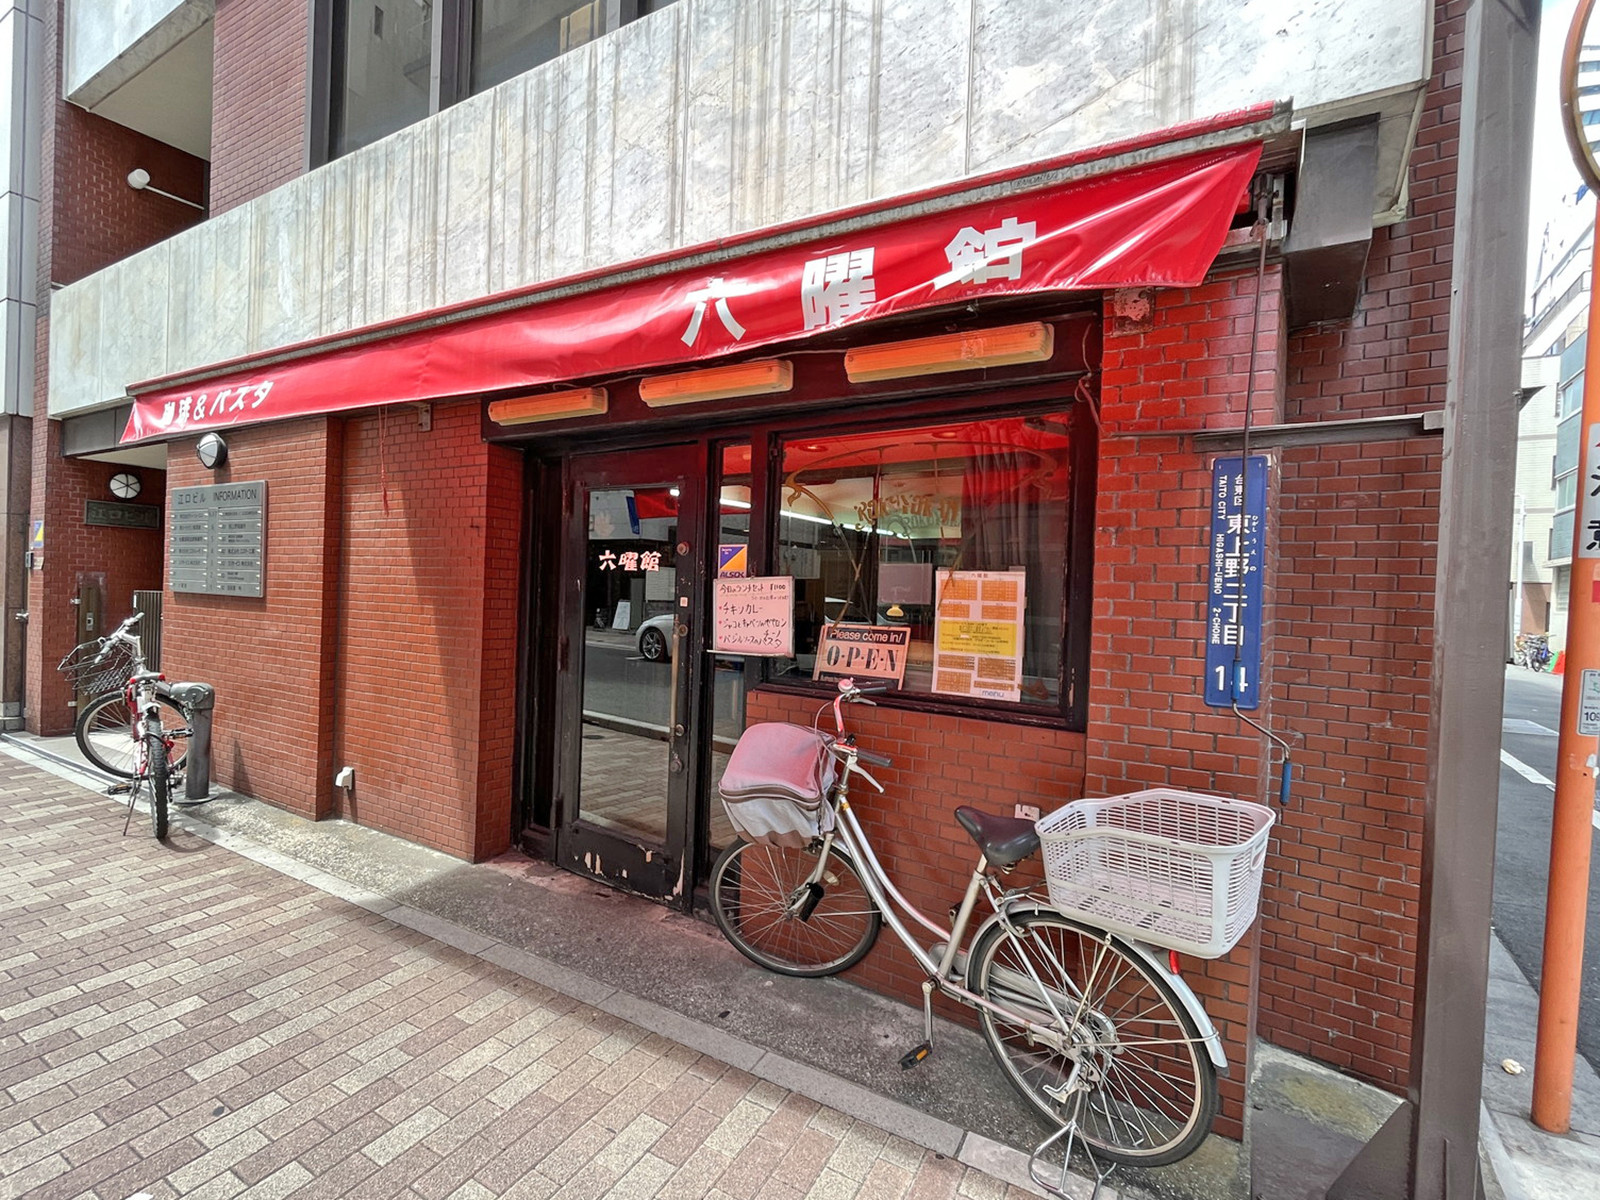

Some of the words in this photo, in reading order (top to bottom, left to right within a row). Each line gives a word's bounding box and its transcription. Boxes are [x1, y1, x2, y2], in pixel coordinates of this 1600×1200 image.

[680, 217, 1037, 347] 六曜館
[213, 488, 257, 501] INFORMATION
[1218, 475, 1228, 498] TAITO
[1217, 501, 1227, 520] CITY
[598, 550, 662, 572] 六曜館
[1214, 533, 1225, 595] HIGASHI-UENO
[1222, 513, 1251, 646] 東上野二丁目
[722, 602, 763, 615] チキンカレー
[830, 629, 860, 641] Please
[862, 632, 888, 643] come
[1211, 607, 1222, 645] 2-CHOME
[981, 689, 1005, 698] menu
